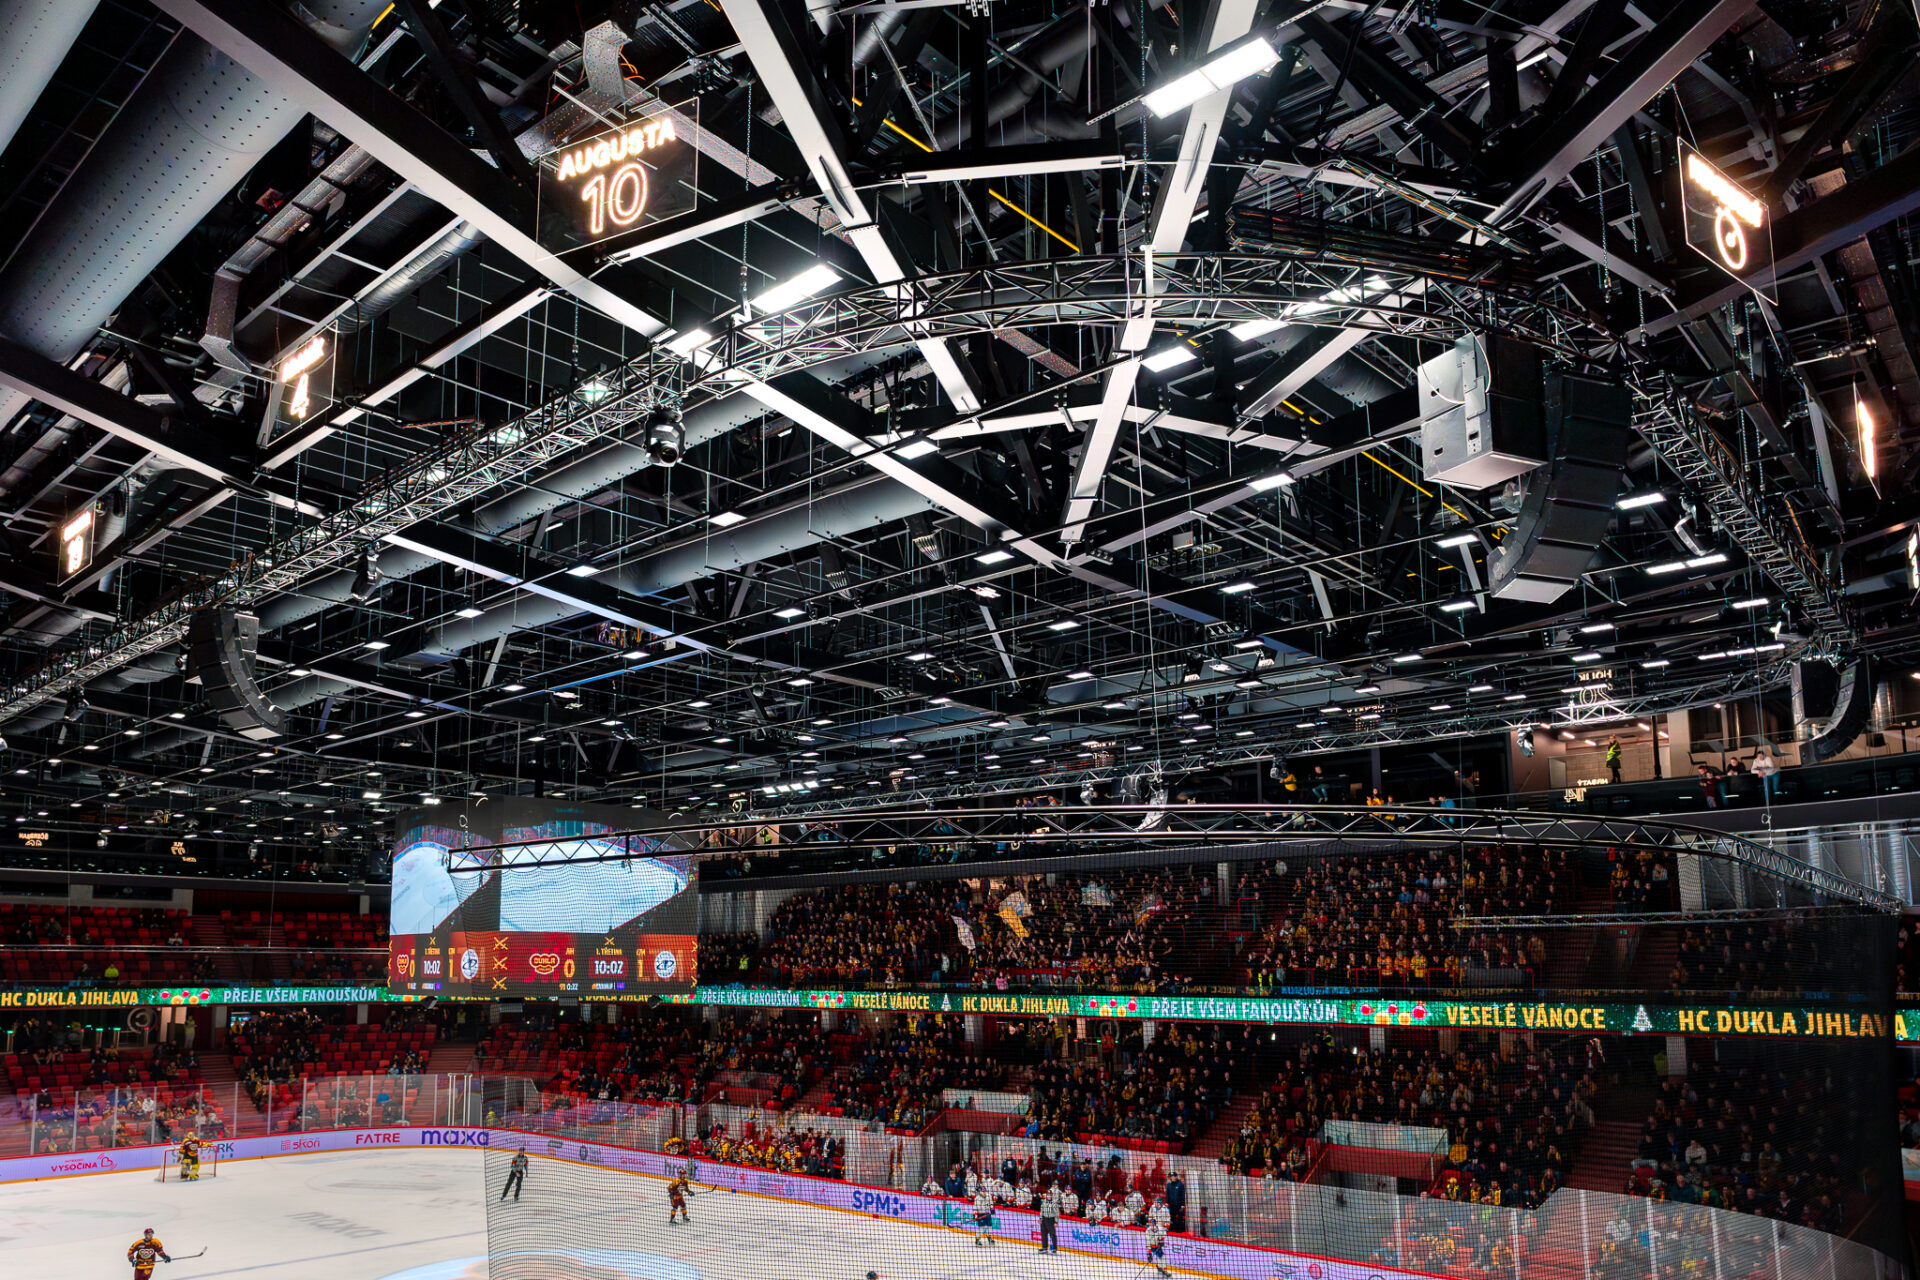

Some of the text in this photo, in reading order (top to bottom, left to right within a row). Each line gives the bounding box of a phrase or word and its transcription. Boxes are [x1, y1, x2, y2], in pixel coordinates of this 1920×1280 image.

[558, 118, 676, 181] AUGUSTA
[581, 163, 647, 234] 10
[424, 961, 440, 974] 10:02
[564, 959, 575, 978] 0
[594, 960, 624, 975] 10:02
[1, 991, 138, 1006] HC DUKLA JIHLAVA
[224, 986, 377, 1003] PŘEJE VŠEM FANOUŠKŮM
[702, 989, 800, 1006] PŘEJE VŠEM FANOUŠKŮM
[853, 992, 929, 1010] VESELÉ VÁNOCE
[963, 997, 1069, 1014] HC DUKLA JIHLAVA
[1152, 998, 1338, 1021] PŘEJE VŠEM FANOUŠKŮM
[1446, 1002, 1606, 1029] VESELÉ VÁNOCE
[1679, 1010, 1908, 1039] HC DUKLA JIHLAVA
[356, 1132, 400, 1145] FATRE
[421, 1129, 489, 1146] maxa
[51, 1162, 97, 1173] VYSOČINA
[853, 1190, 890, 1215] SPM
